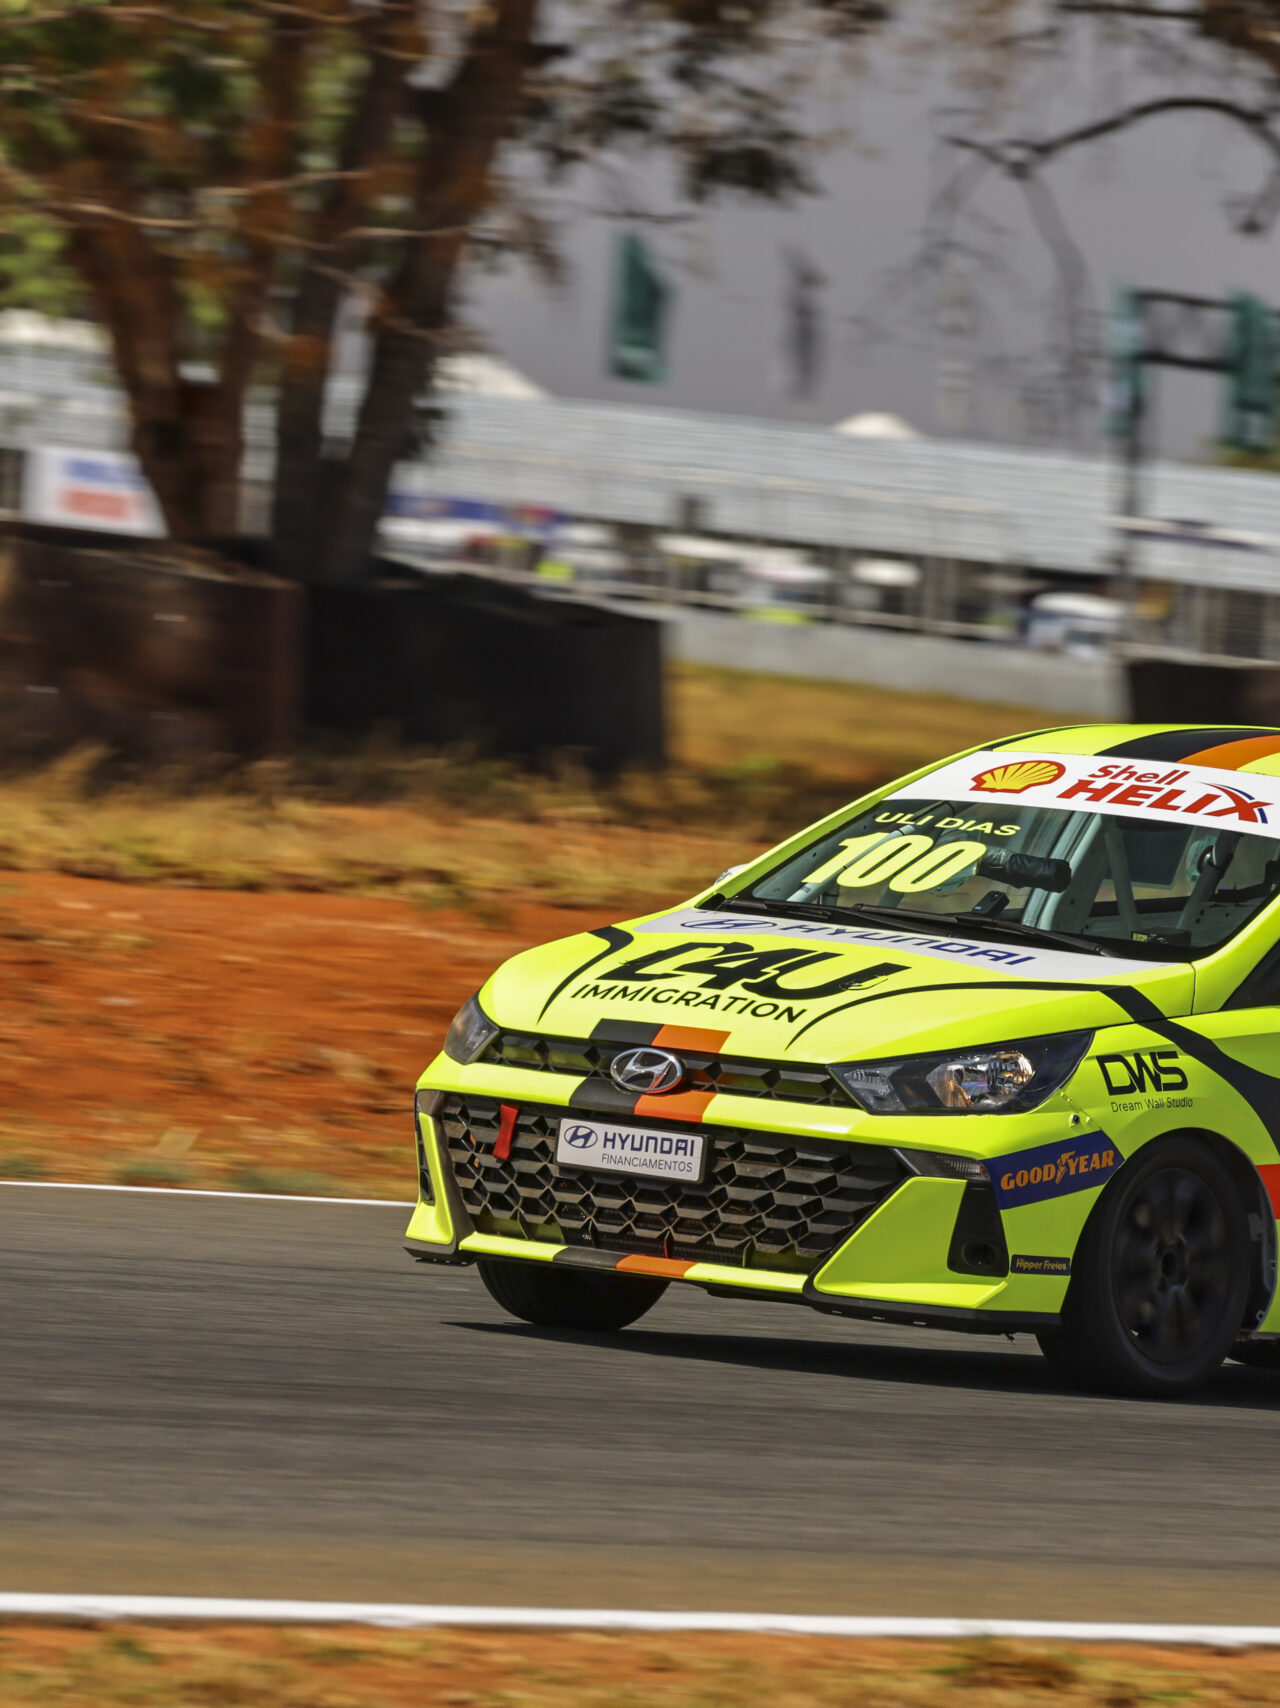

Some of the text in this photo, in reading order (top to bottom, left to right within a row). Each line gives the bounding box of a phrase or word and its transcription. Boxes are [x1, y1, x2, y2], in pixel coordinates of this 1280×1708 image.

[1096, 764, 1190, 786] Shell
[1056, 779, 1274, 824] HELIX
[874, 811, 1022, 837] ULI DIAS
[802, 831, 988, 893] 100
[782, 925, 1038, 966] HYUNDAI
[595, 941, 913, 1001] D4U
[571, 983, 807, 1024] IMMIGRATION
[1096, 1050, 1189, 1097] DWS
[1110, 1096, 1194, 1113] Dream Wall Studio
[602, 1131, 696, 1157] HYUNDAI
[601, 1153, 694, 1173] FINANCIAMENTOS
[1016, 1257, 1068, 1271] Hipper Freios
